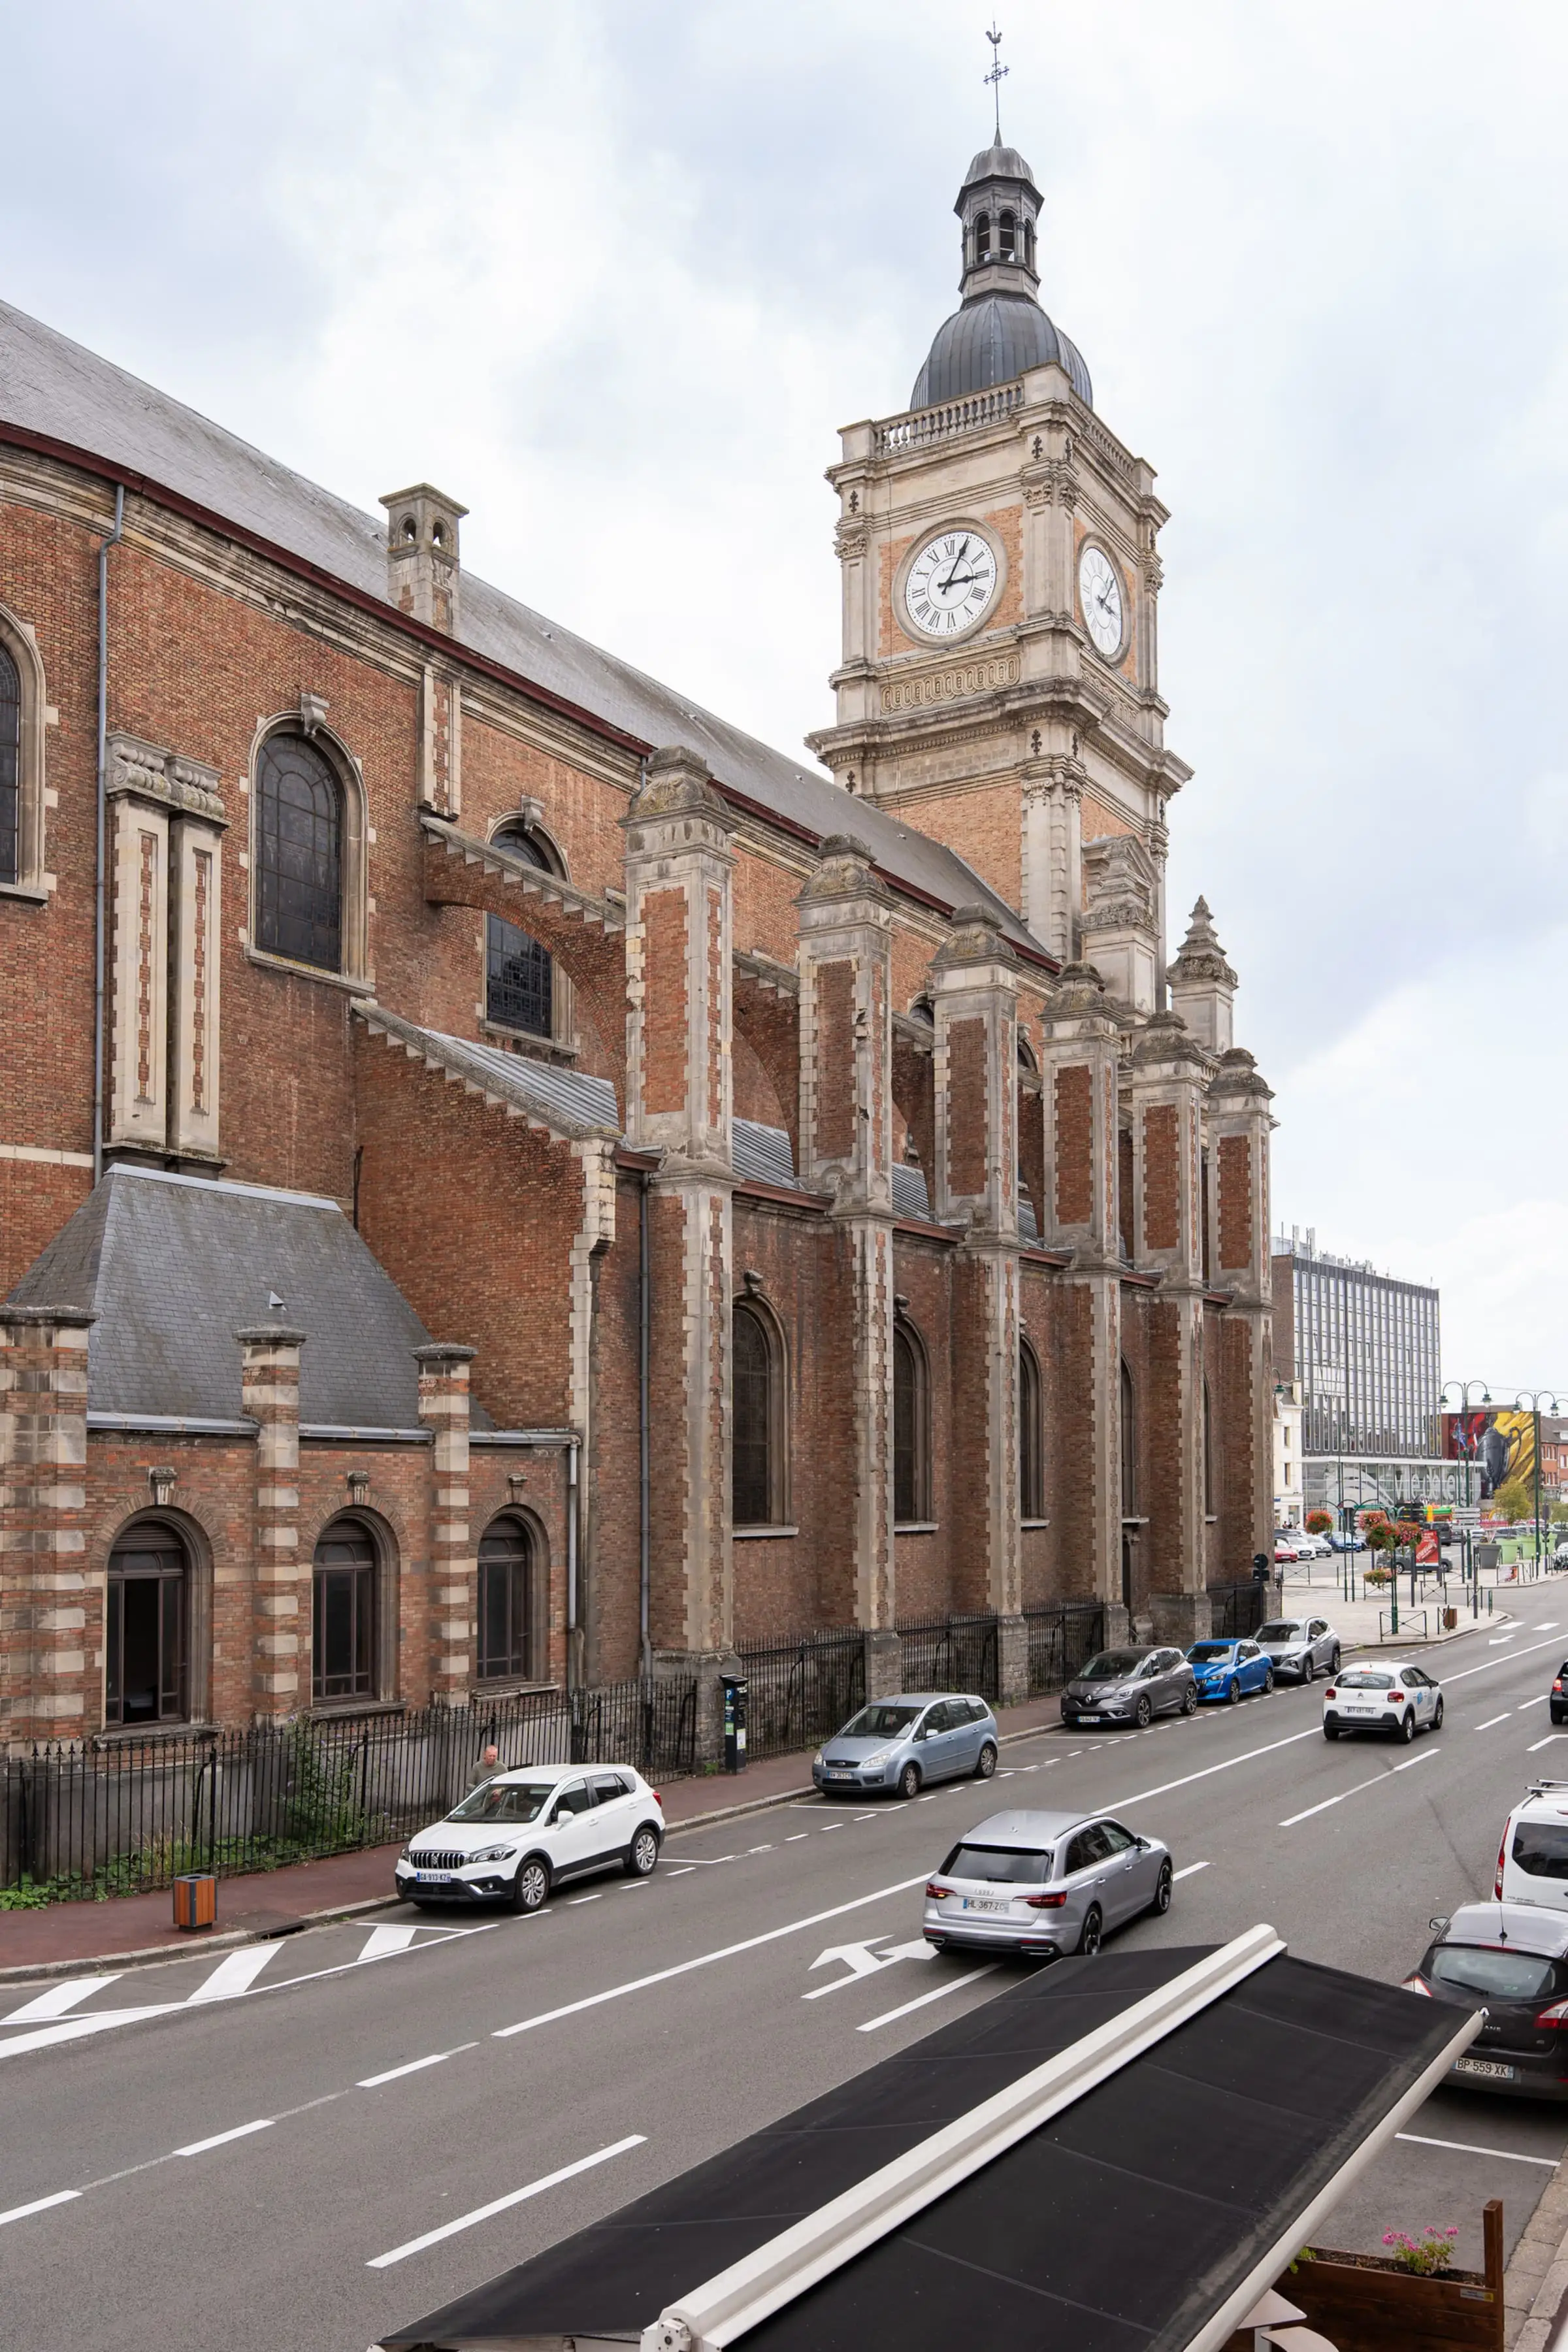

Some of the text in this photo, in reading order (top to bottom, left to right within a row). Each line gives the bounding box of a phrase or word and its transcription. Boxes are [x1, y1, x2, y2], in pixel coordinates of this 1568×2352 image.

[944, 540, 955, 557] XII
[927, 549, 940, 566] XI
[971, 549, 985, 564] II
[916, 568, 929, 578] X
[975, 569, 989, 580] III
[912, 588, 925, 598] IX
[915, 600, 931, 620] VIII
[964, 604, 973, 618] V
[928, 610, 941, 628] VII
[947, 612, 956, 628] VI
[726, 1689, 732, 1699] P
